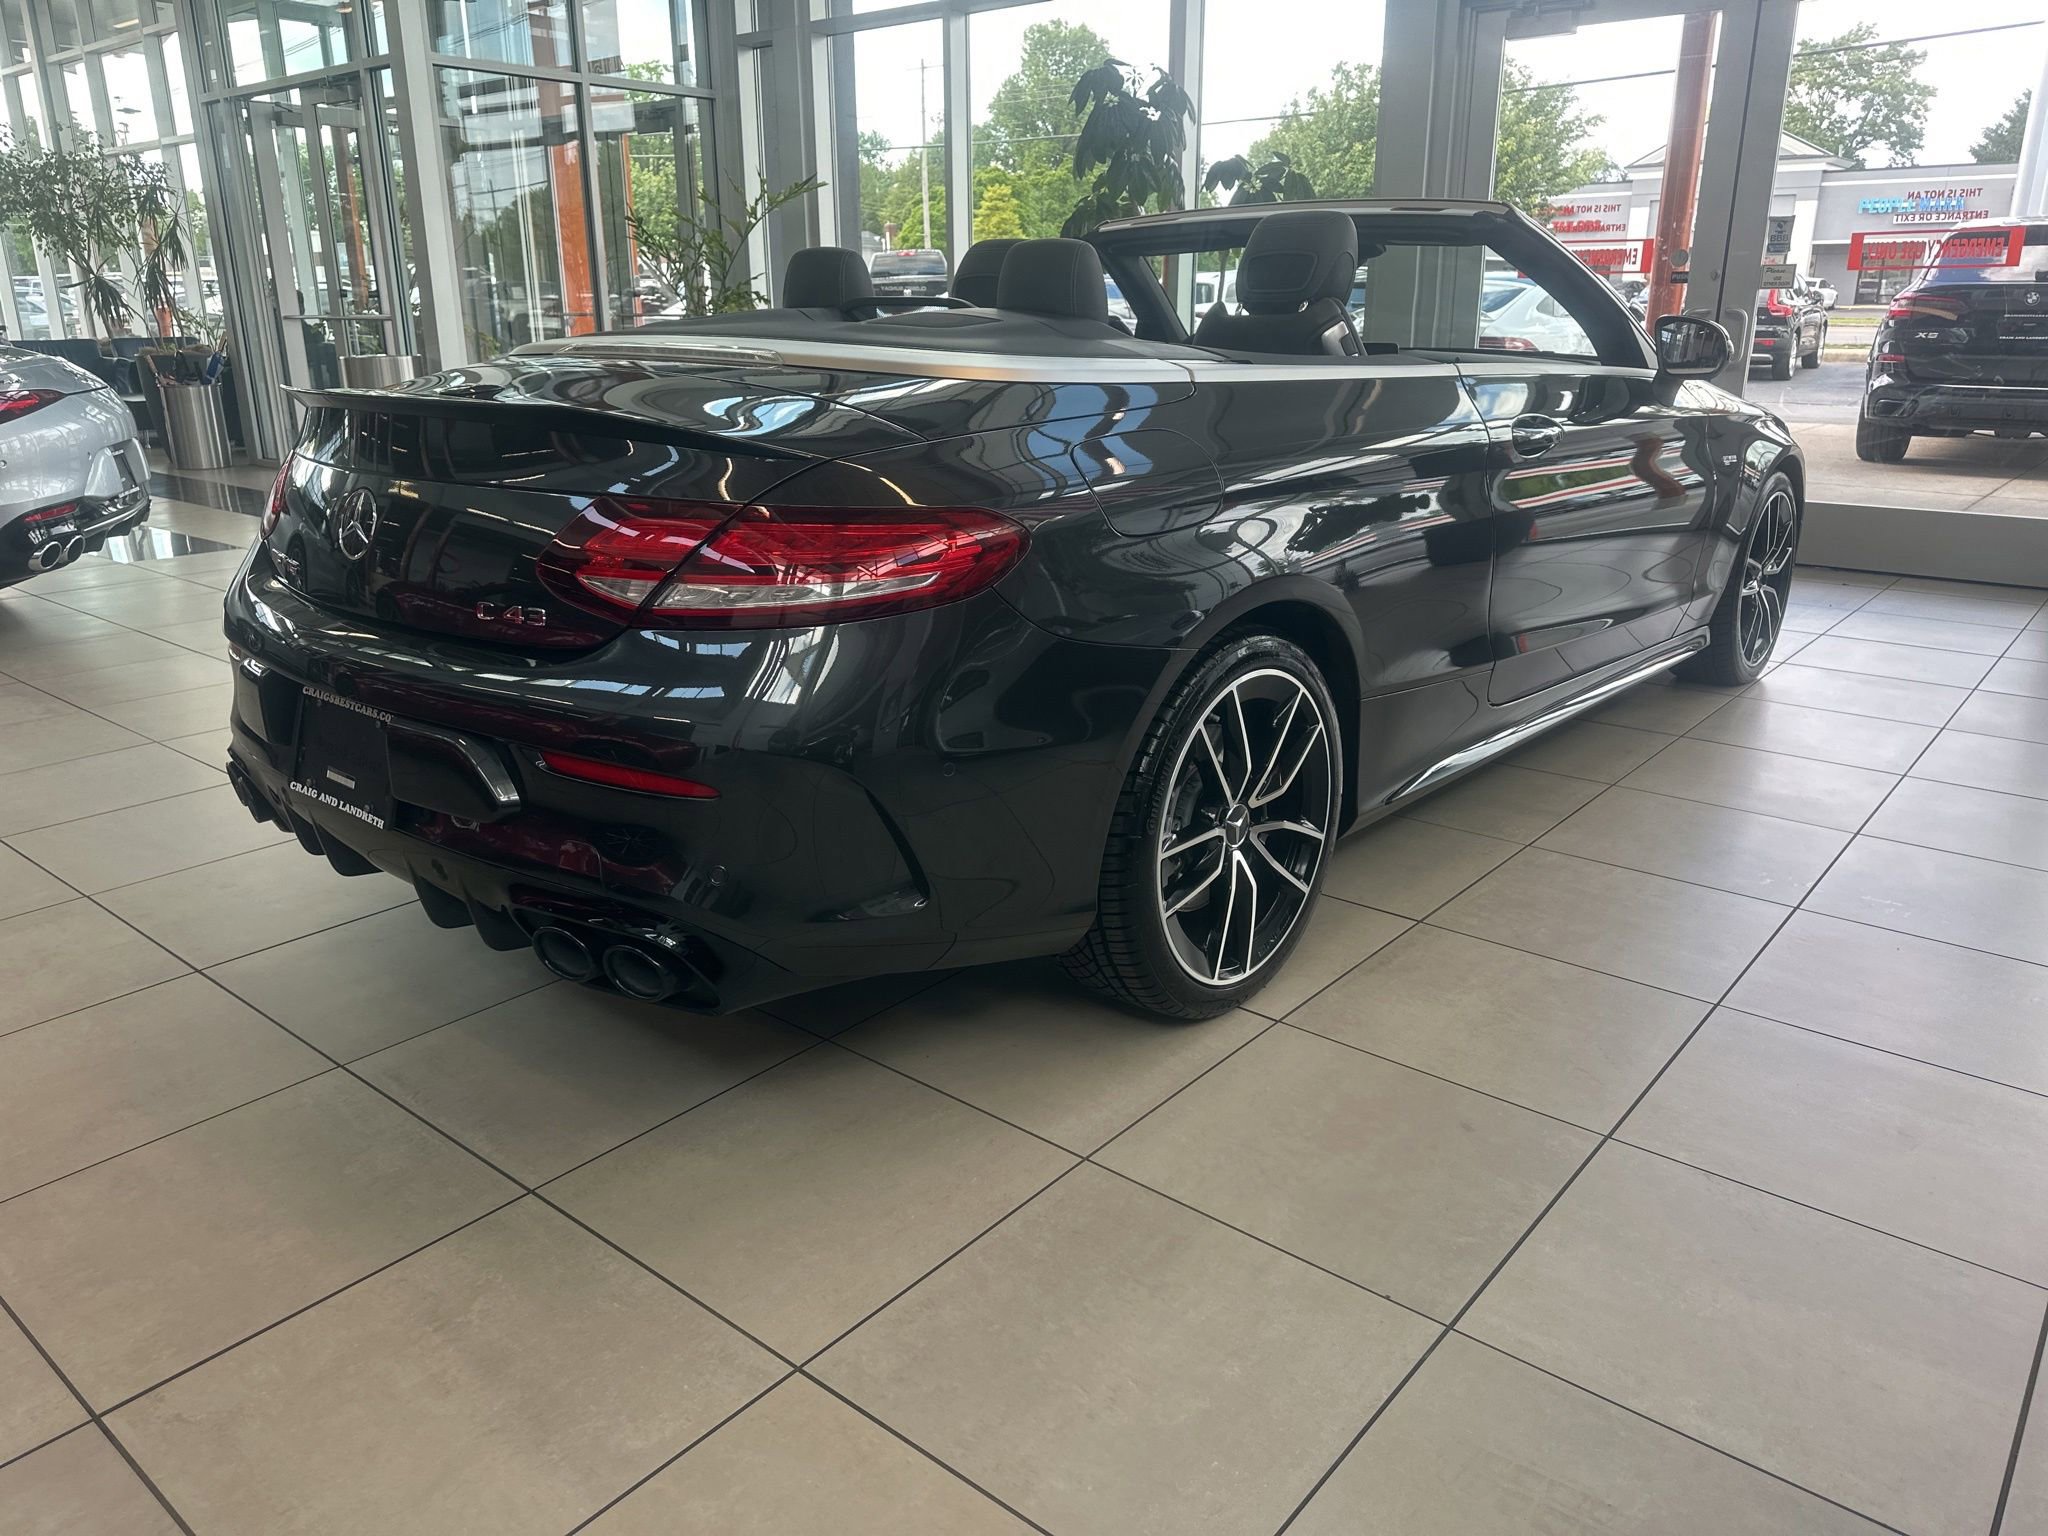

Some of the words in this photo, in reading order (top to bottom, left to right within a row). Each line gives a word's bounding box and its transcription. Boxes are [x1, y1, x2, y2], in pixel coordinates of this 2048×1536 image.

[476, 601, 495, 620] C
[503, 605, 547, 627] 43
[302, 686, 394, 723] CRAIGSBESTCARS.CO
[289, 781, 318, 798] CRAIG
[318, 792, 338, 807] AND
[339, 800, 385, 830] LANDRETH
